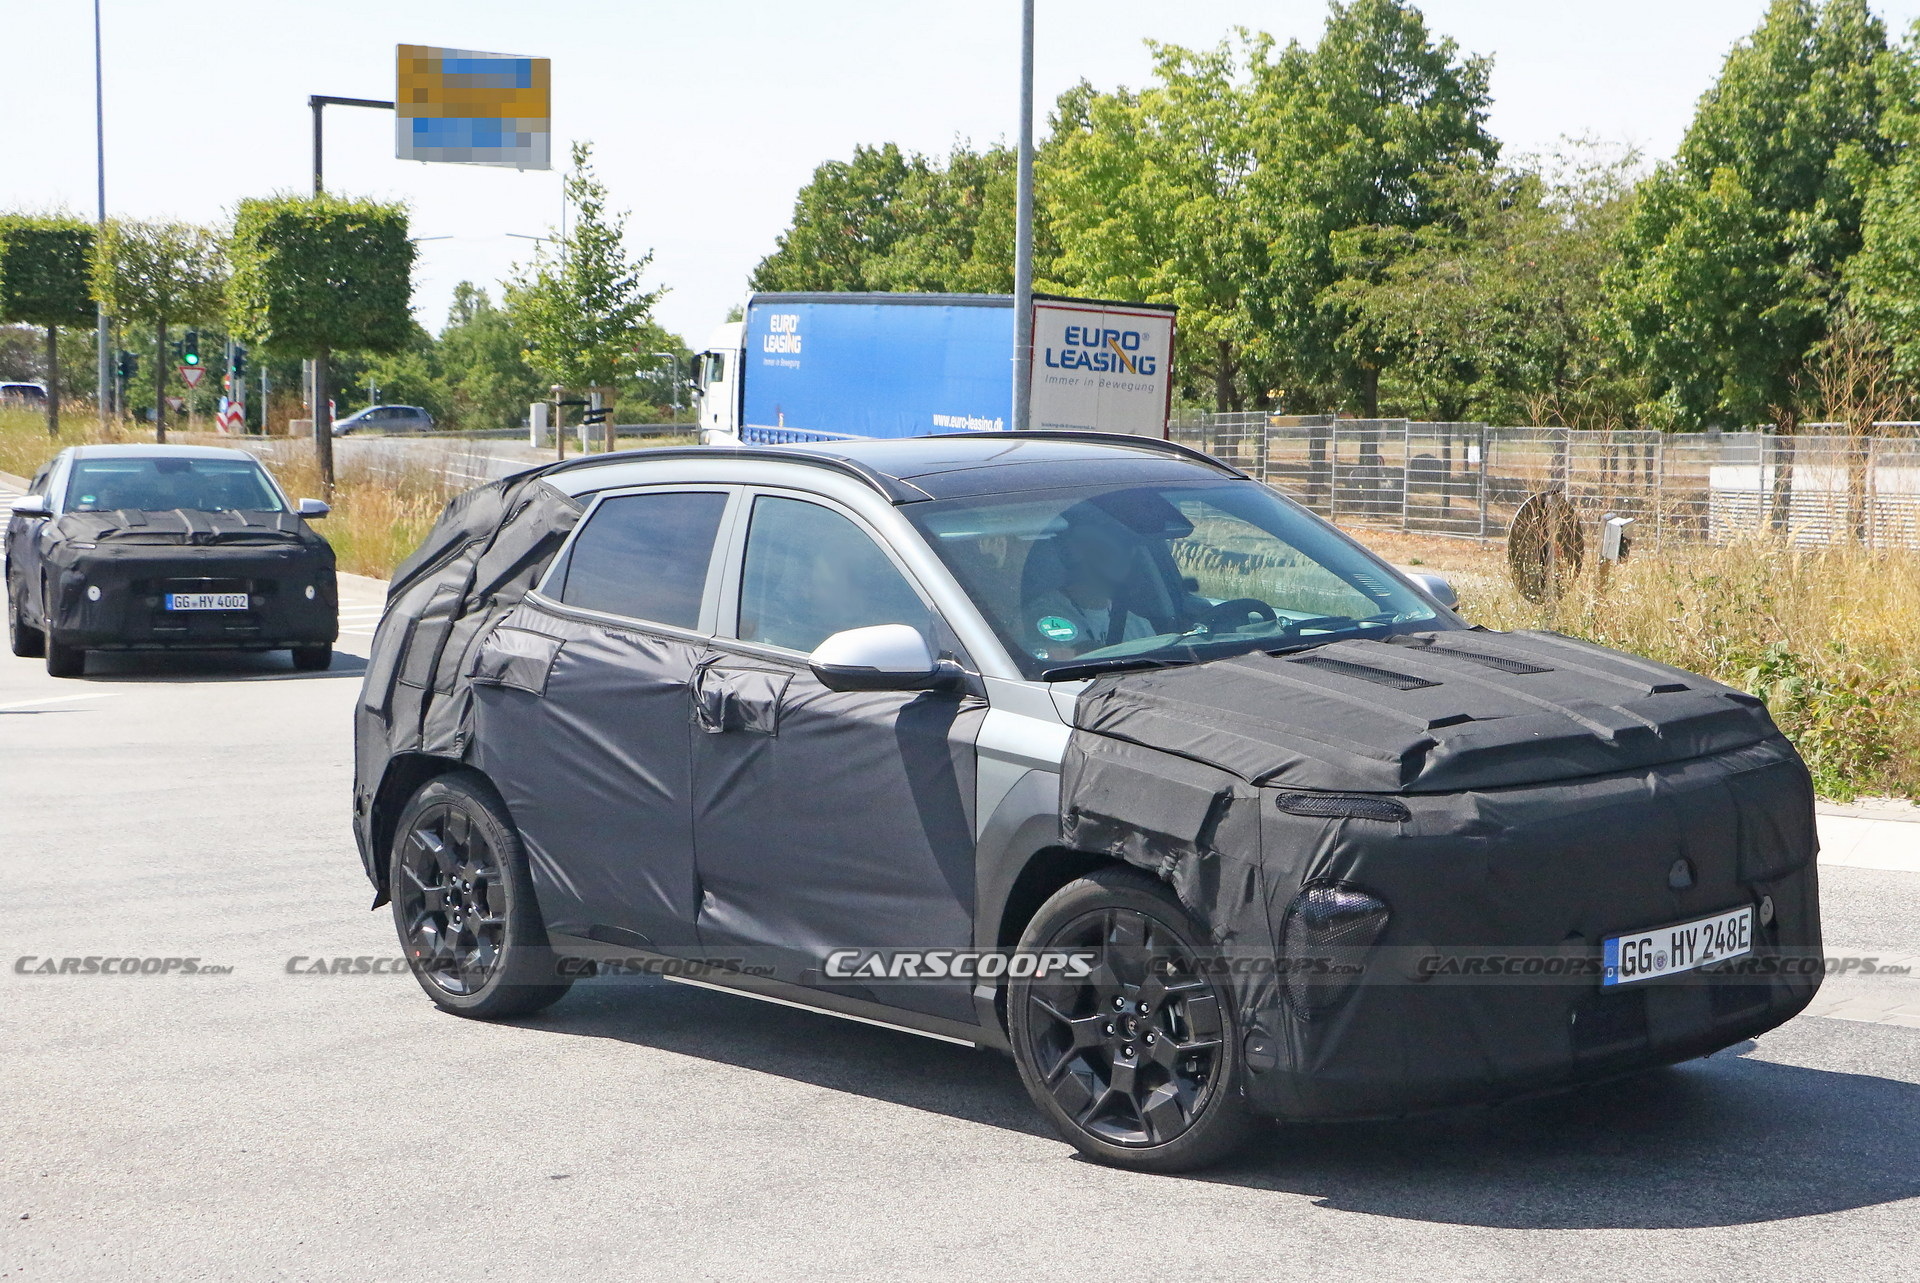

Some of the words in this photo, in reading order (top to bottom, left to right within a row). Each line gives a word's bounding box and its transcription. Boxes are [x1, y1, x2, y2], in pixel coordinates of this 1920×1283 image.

[771, 314, 797, 332] EURO
[764, 334, 801, 353] LEASING
[1064, 325, 1140, 351] EURO
[1045, 347, 1156, 376] LEASING
[1045, 374, 1081, 386] Immer
[1083, 377, 1094, 387] in
[1098, 378, 1155, 394] Bewegung
[174, 595, 190, 608] GG
[199, 595, 214, 608] HY
[217, 595, 247, 608] 4002
[1621, 937, 1653, 977] GG
[1671, 927, 1698, 967] HY
[1703, 913, 1749, 960] 248E
[1607, 967, 1614, 978] D
